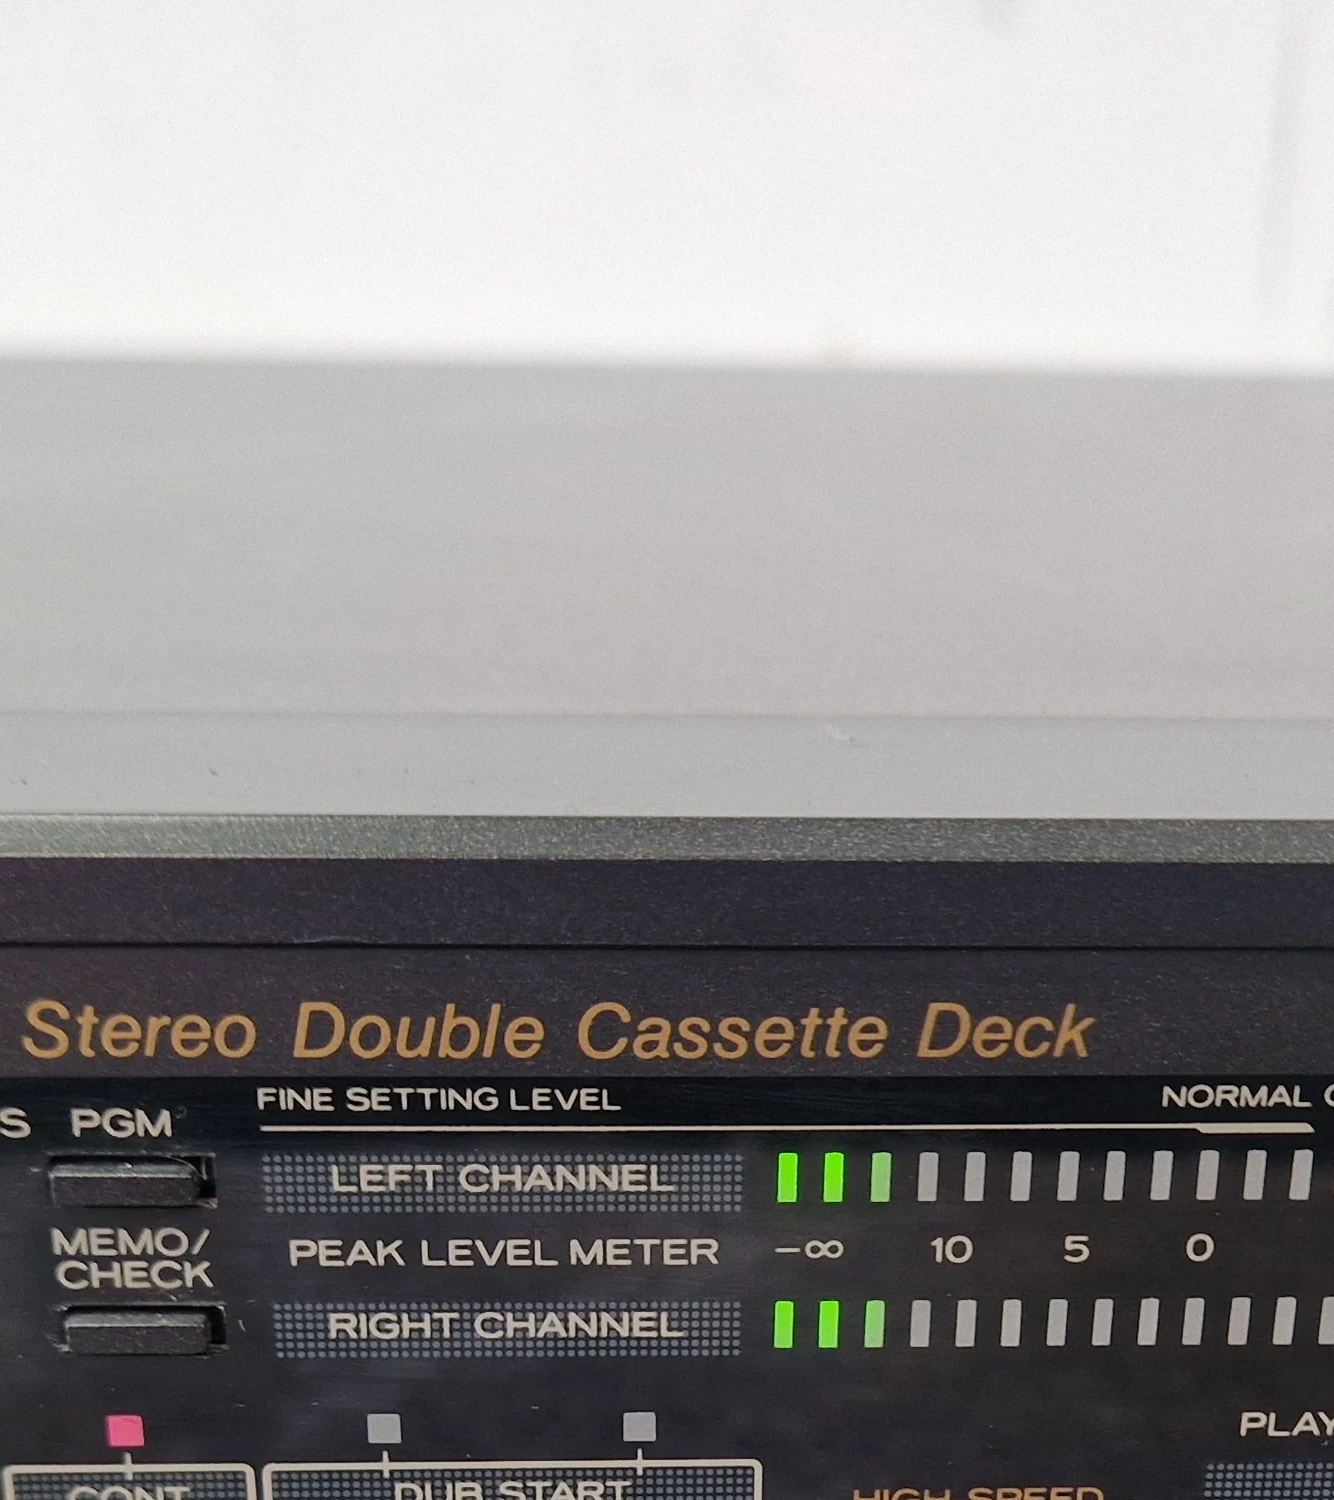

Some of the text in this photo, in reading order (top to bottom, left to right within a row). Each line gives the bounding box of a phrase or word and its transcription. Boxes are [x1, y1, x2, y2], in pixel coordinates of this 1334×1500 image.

[22, 1001, 257, 1059] Stereo
[292, 1001, 545, 1060] Double
[577, 1001, 889, 1060] Cassette
[916, 1002, 1097, 1060] Deck
[257, 1085, 622, 1112] FINE SETTING LEVEL
[1162, 1084, 1312, 1108] NORMAL
[70, 1107, 173, 1138] PGM
[330, 1162, 676, 1193] LEFT CHANNEL
[50, 1227, 211, 1258] MEMO/
[289, 1238, 720, 1267] PEAK LEVEL METER
[930, 1235, 974, 1264] 10
[1064, 1235, 1091, 1264] 5
[1185, 1233, 1215, 1263] 0
[55, 1260, 214, 1290] CHECK
[327, 1309, 686, 1340] RIGHT CHANNEL
